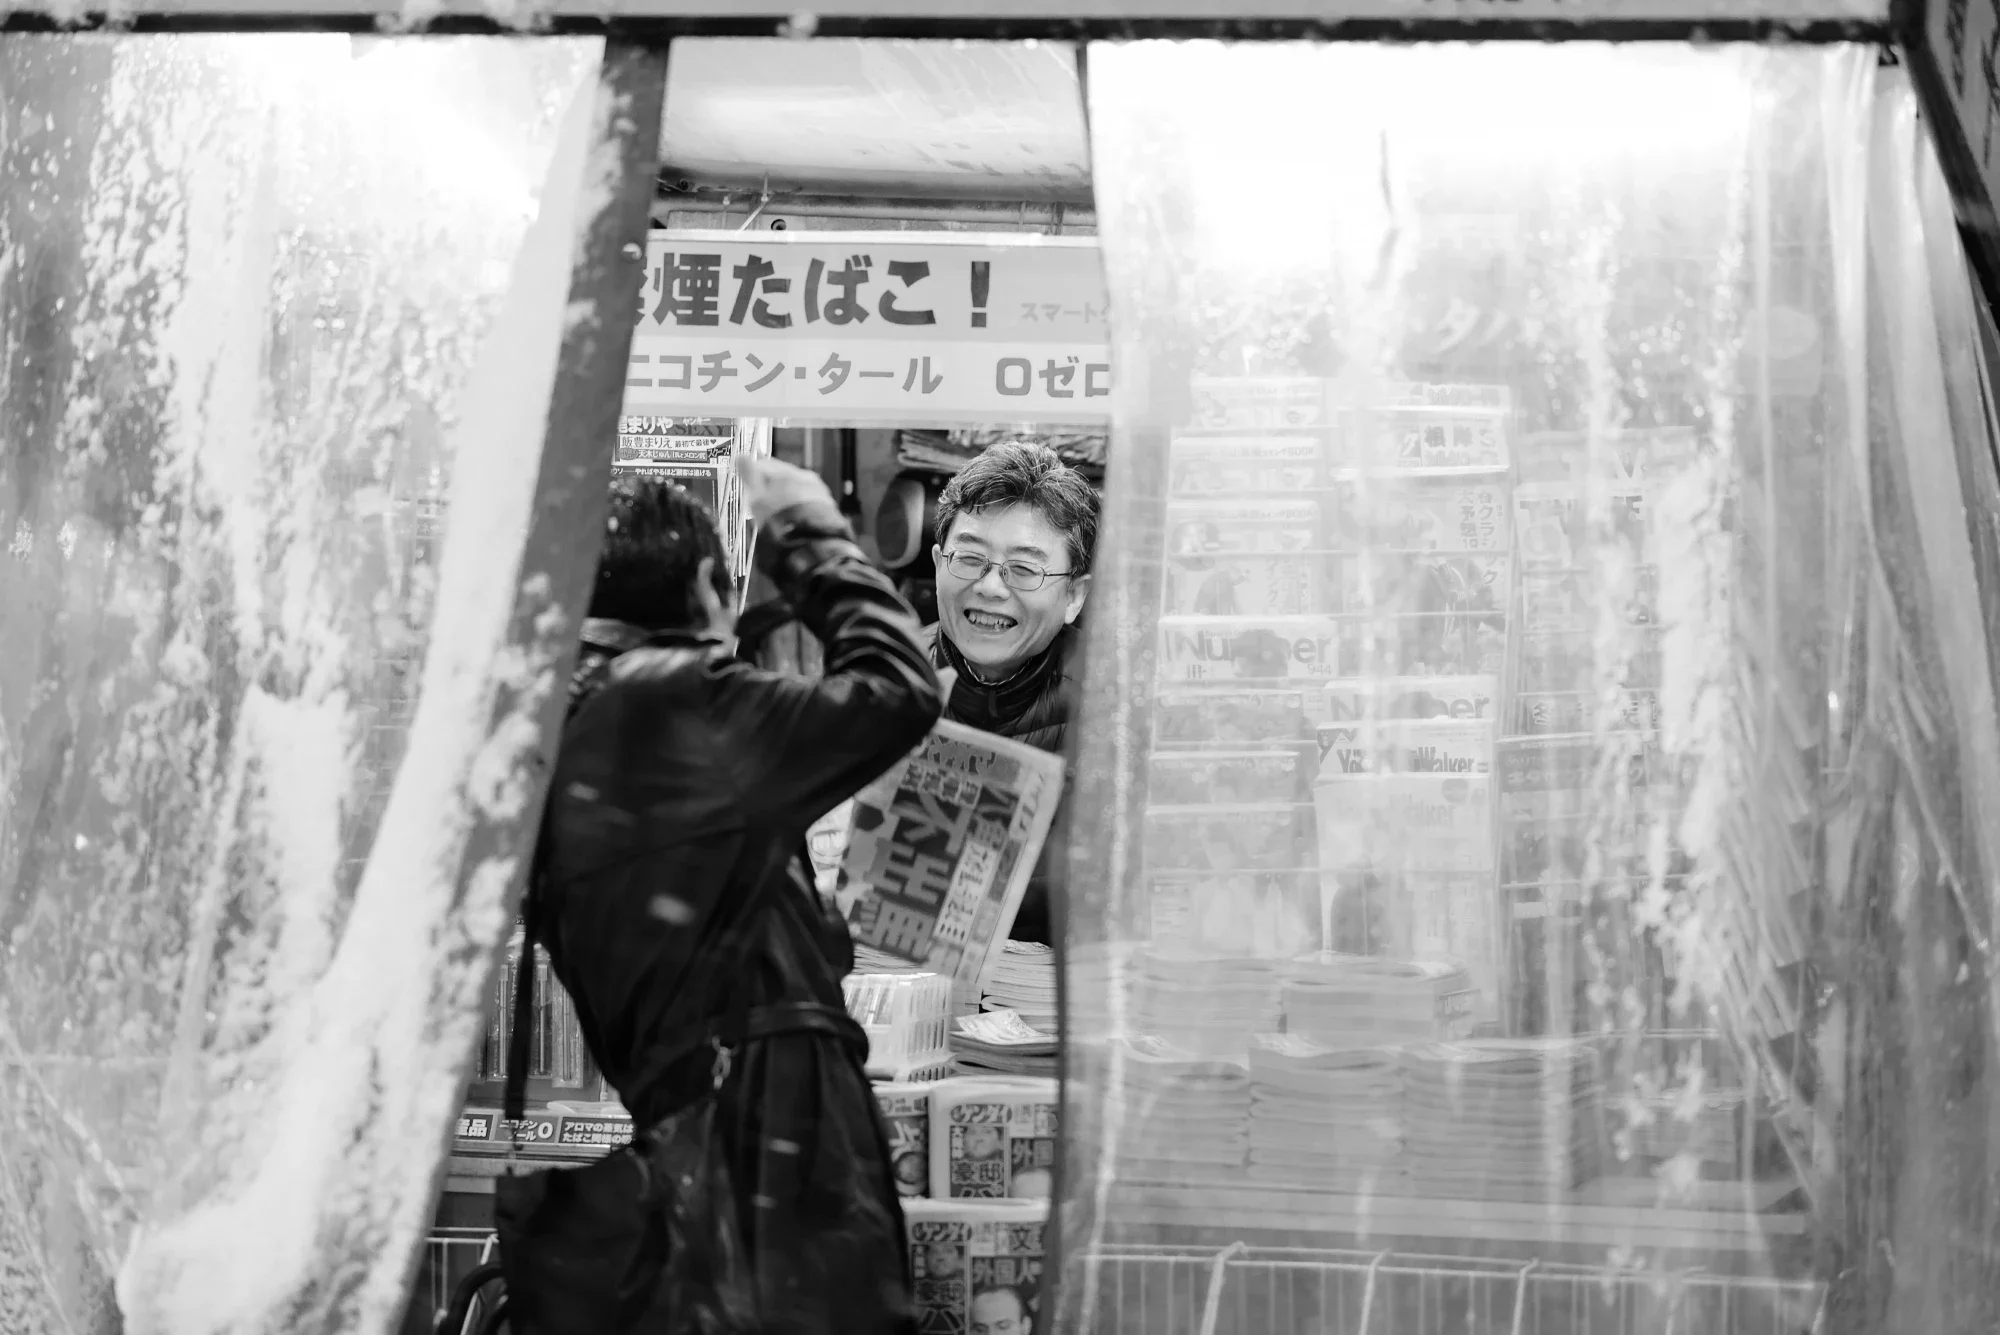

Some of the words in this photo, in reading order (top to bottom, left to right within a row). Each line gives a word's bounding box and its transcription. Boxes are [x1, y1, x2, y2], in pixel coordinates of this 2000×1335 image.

[634, 252, 991, 329] 煙たばこ！
[626, 350, 944, 396] ニコチン・タール
[674, 425, 725, 436] SEXY
[621, 436, 672, 448] 飯豊まりえ
[1174, 629, 1332, 663] Nuer
[1308, 663, 1333, 675] 944
[507, 1130, 537, 1141] ール
